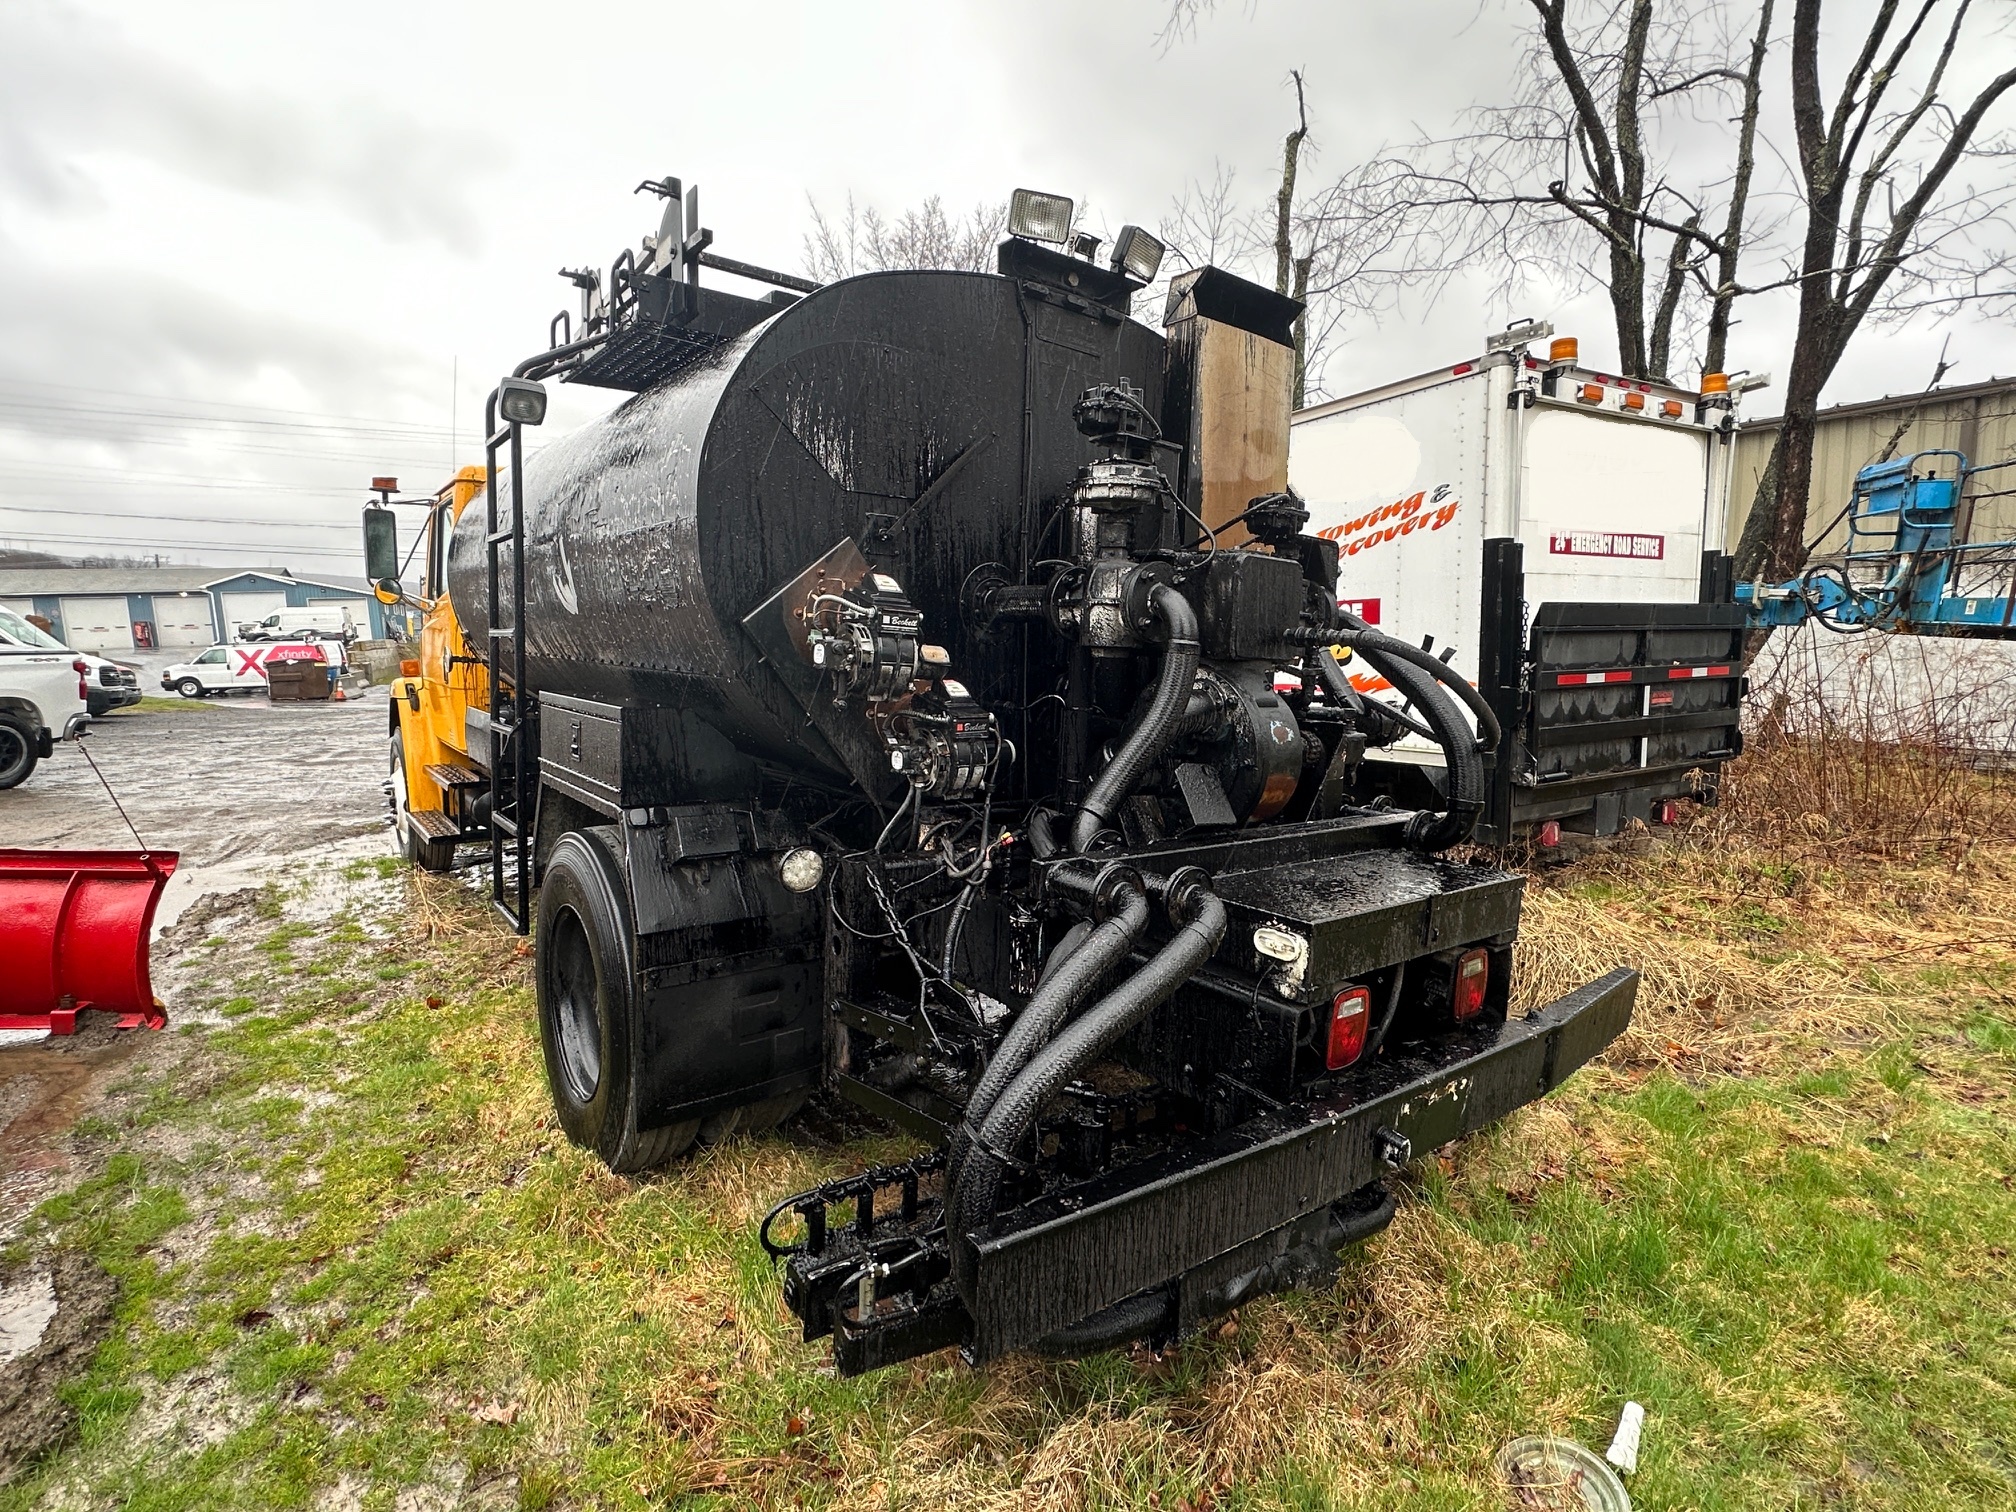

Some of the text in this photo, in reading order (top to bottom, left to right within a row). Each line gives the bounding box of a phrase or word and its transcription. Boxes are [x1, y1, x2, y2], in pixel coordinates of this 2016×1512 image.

[1430, 484, 1452, 503] &
[1339, 501, 1462, 560] ecovery
[1571, 532, 1613, 554] EMERGENCY
[1613, 535, 1632, 555] ROAD
[1632, 536, 1660, 557] SERVICE
[891, 616, 918, 627] Beckett
[278, 649, 312, 659] xfinity
